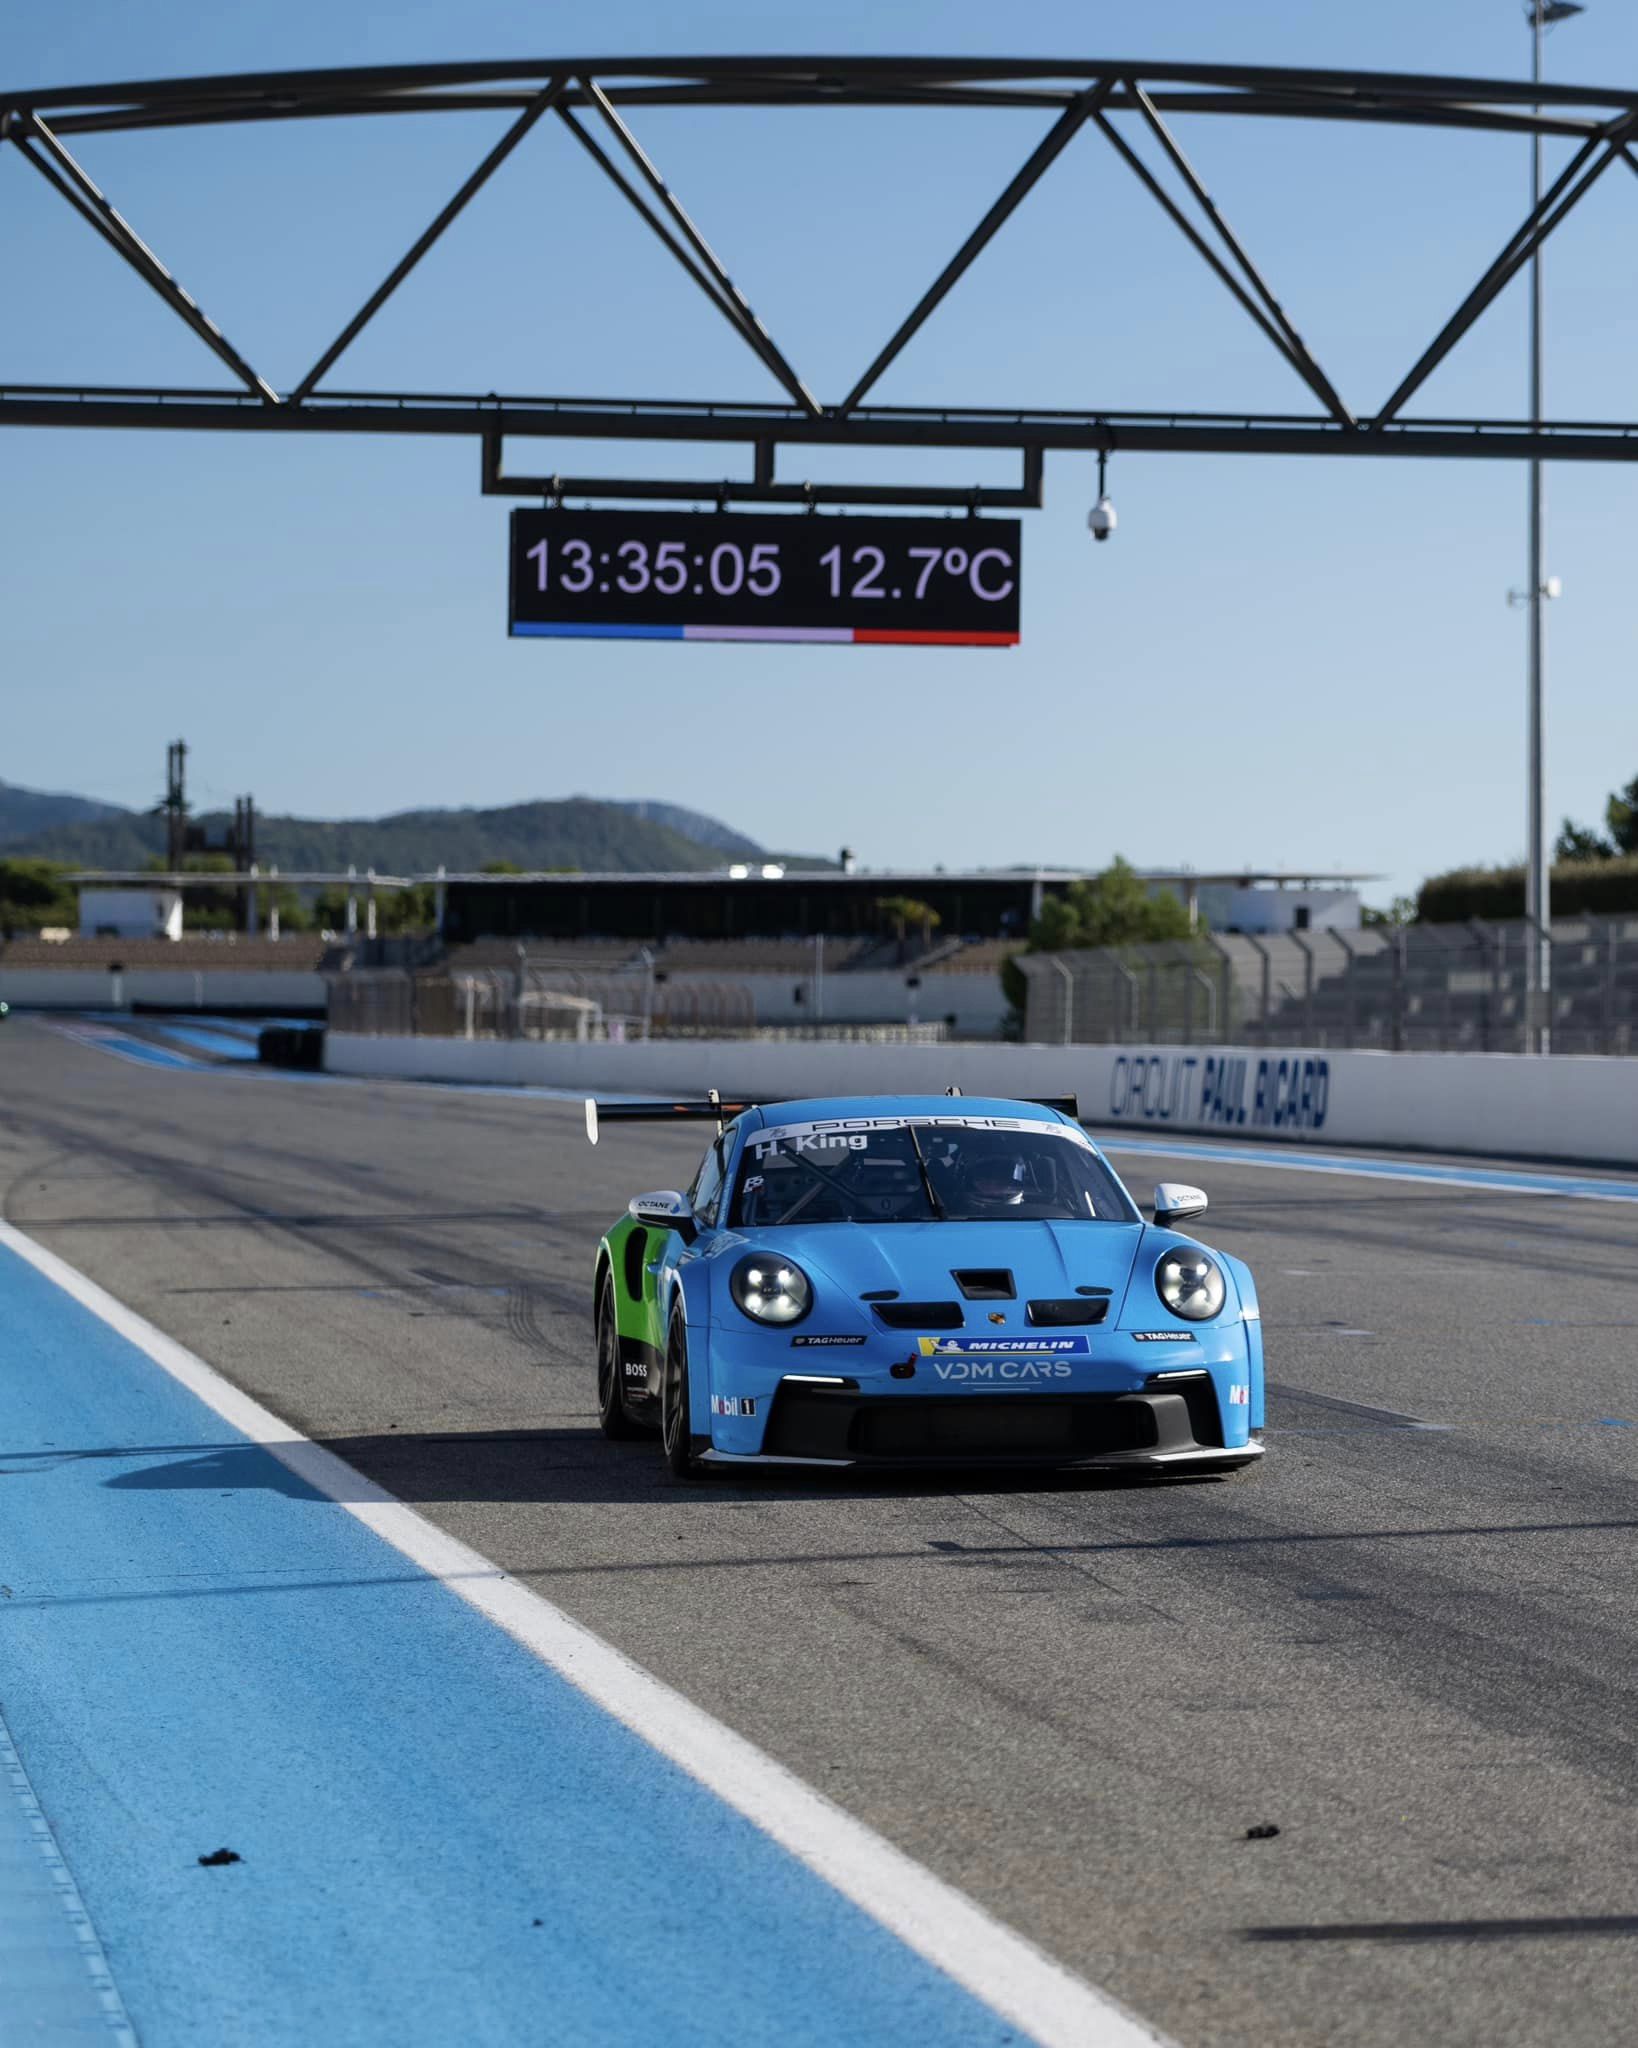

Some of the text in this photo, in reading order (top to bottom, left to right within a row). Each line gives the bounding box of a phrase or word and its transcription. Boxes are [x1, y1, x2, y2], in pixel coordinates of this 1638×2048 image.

[526, 538, 781, 597] 13:35:05
[1110, 1055, 1330, 1129] CIRCUIT PAUL RICARD
[812, 1118, 1021, 1132] PORSCHE
[755, 1134, 868, 1160] H. King
[638, 1200, 670, 1209] OCTANE
[968, 1340, 1075, 1350] MICHELIN
[625, 1363, 648, 1377] BOSS
[933, 1360, 1072, 1379] VDM CARS
[711, 1394, 738, 1416] Mobil
